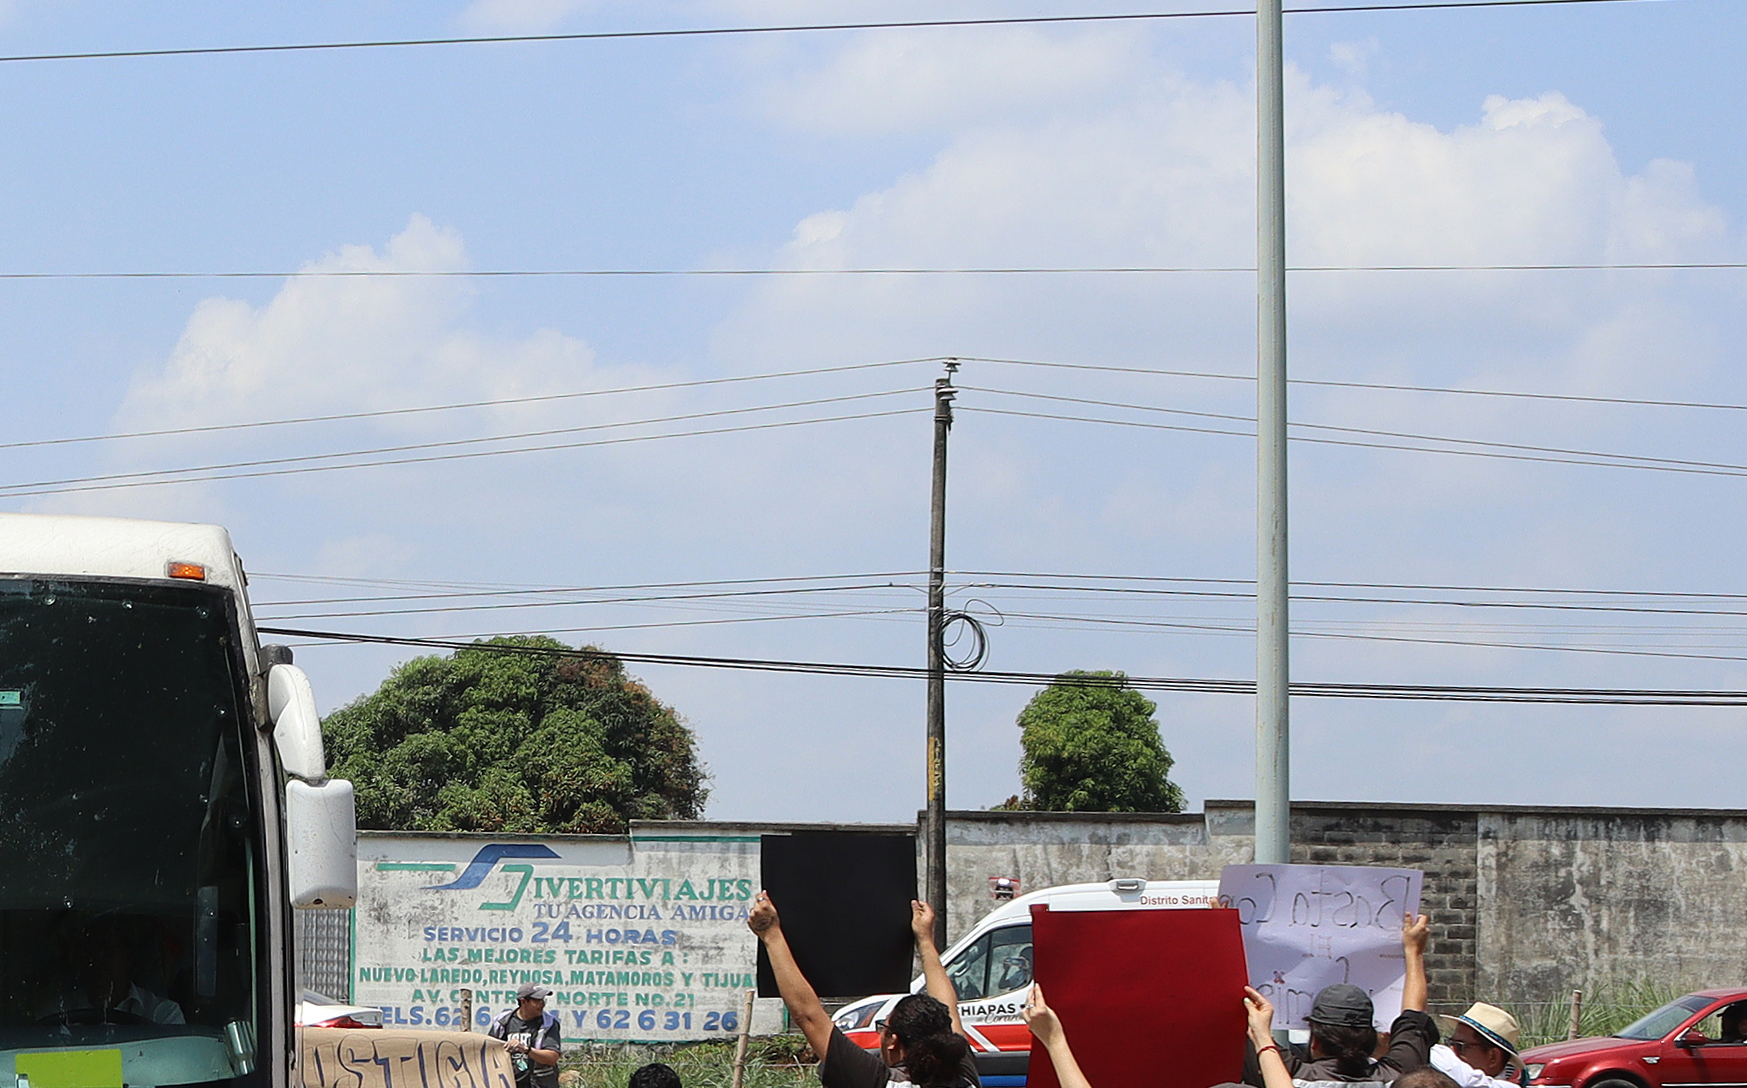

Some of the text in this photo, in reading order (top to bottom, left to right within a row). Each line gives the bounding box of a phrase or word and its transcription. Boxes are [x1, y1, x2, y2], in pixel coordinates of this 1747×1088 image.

[1139, 895, 1179, 906] Distrito
[533, 903, 751, 921] TU AGENCIA AMIGA
[423, 921, 677, 946] SERVICIO 24 HORAS
[422, 947, 460, 963] LAS
[467, 948, 556, 965] MEJORES
[563, 950, 652, 966] TARIFAS
[359, 967, 415, 983] NUEVO
[682, 972, 694, 987] Y
[703, 973, 758, 988] TIJUA
[411, 989, 443, 1004] AV.
[557, 991, 629, 1007] NORTE
[571, 1010, 588, 1029] Y
[596, 1009, 631, 1030] 62
[638, 1009, 656, 1031] 6
[663, 1011, 692, 1030] 31
[702, 1011, 739, 1031] 26
